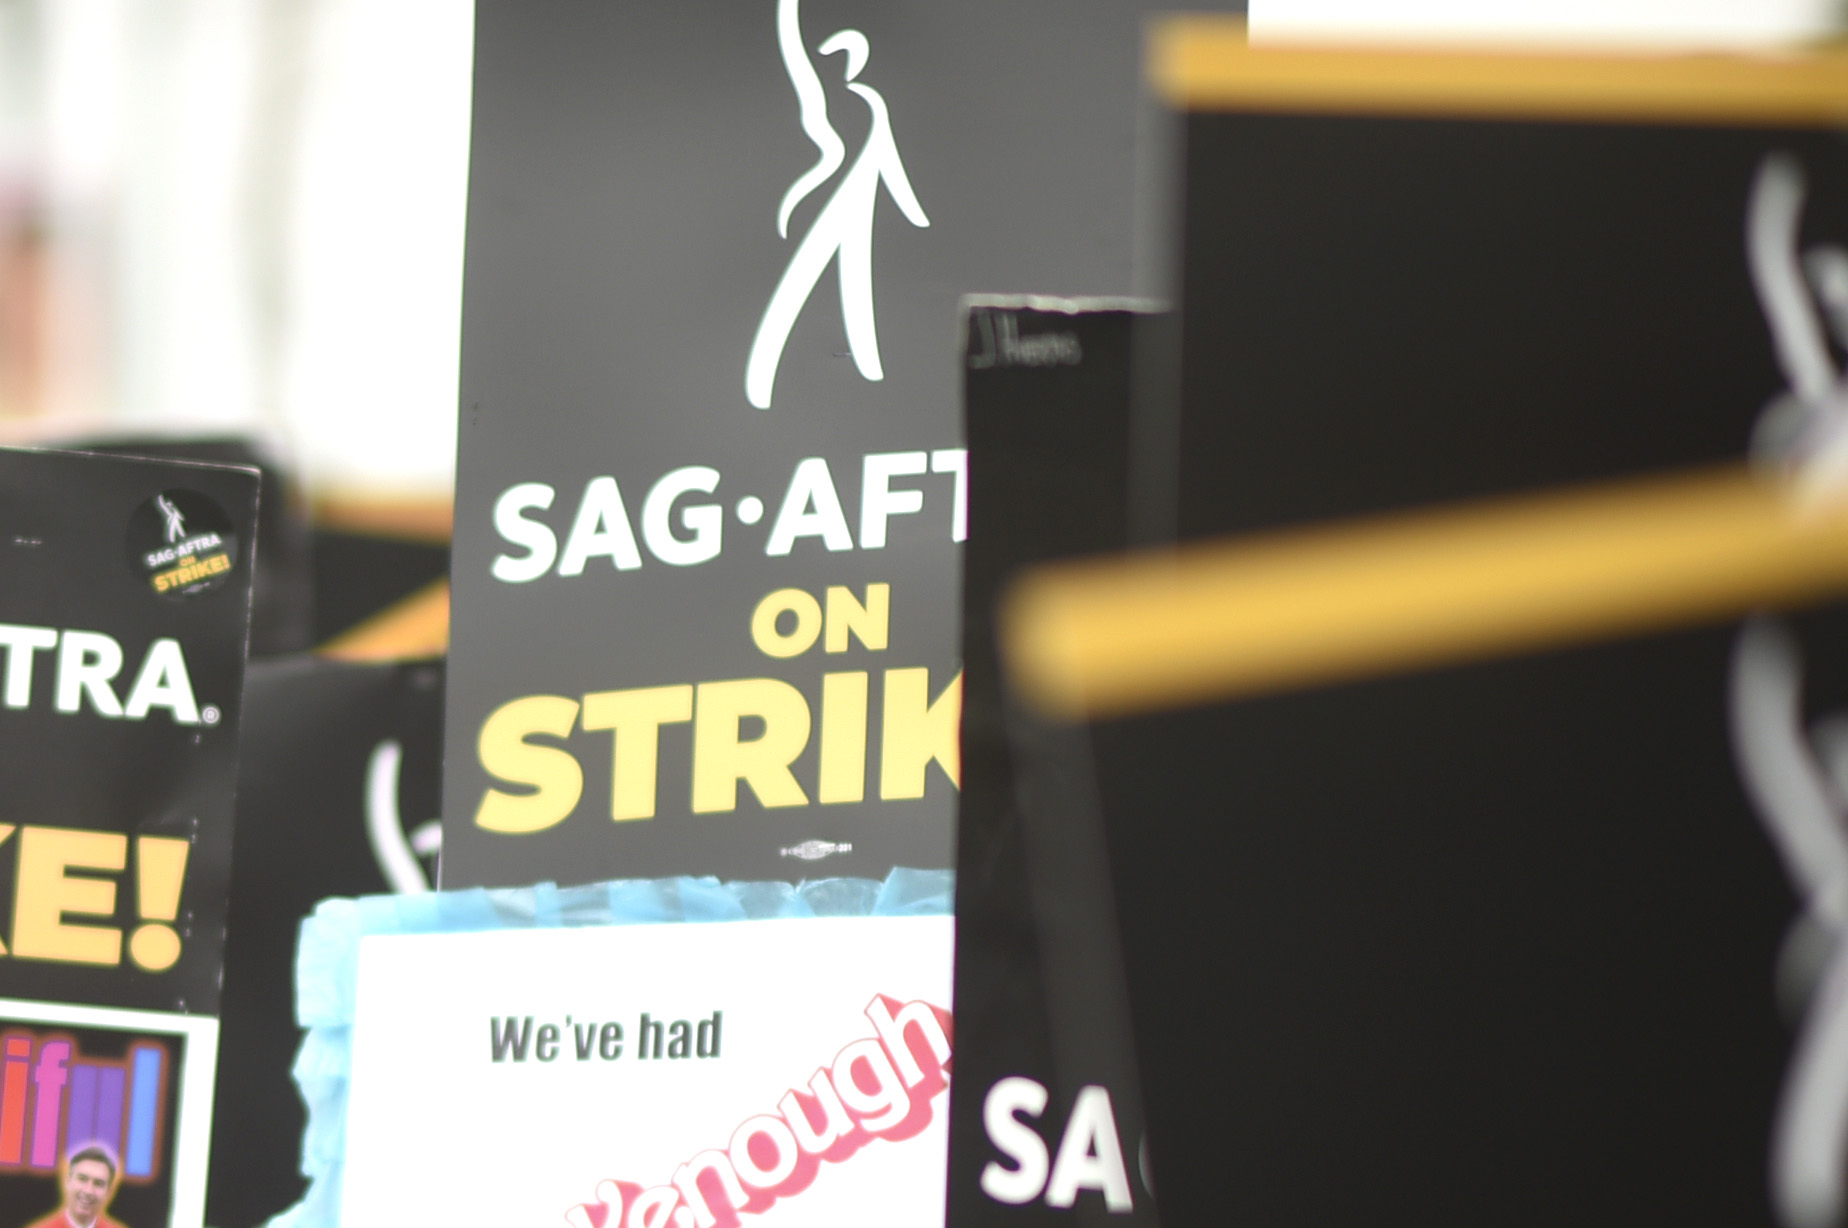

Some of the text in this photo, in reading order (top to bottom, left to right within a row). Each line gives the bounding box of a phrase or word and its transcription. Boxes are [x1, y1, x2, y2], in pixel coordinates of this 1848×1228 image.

[154, 553, 231, 592] STRIKE!
[752, 583, 890, 658] ON
[475, 667, 963, 834] STRIK
[490, 1011, 723, 1063] We’ve had
[980, 1076, 1150, 1213] SA
